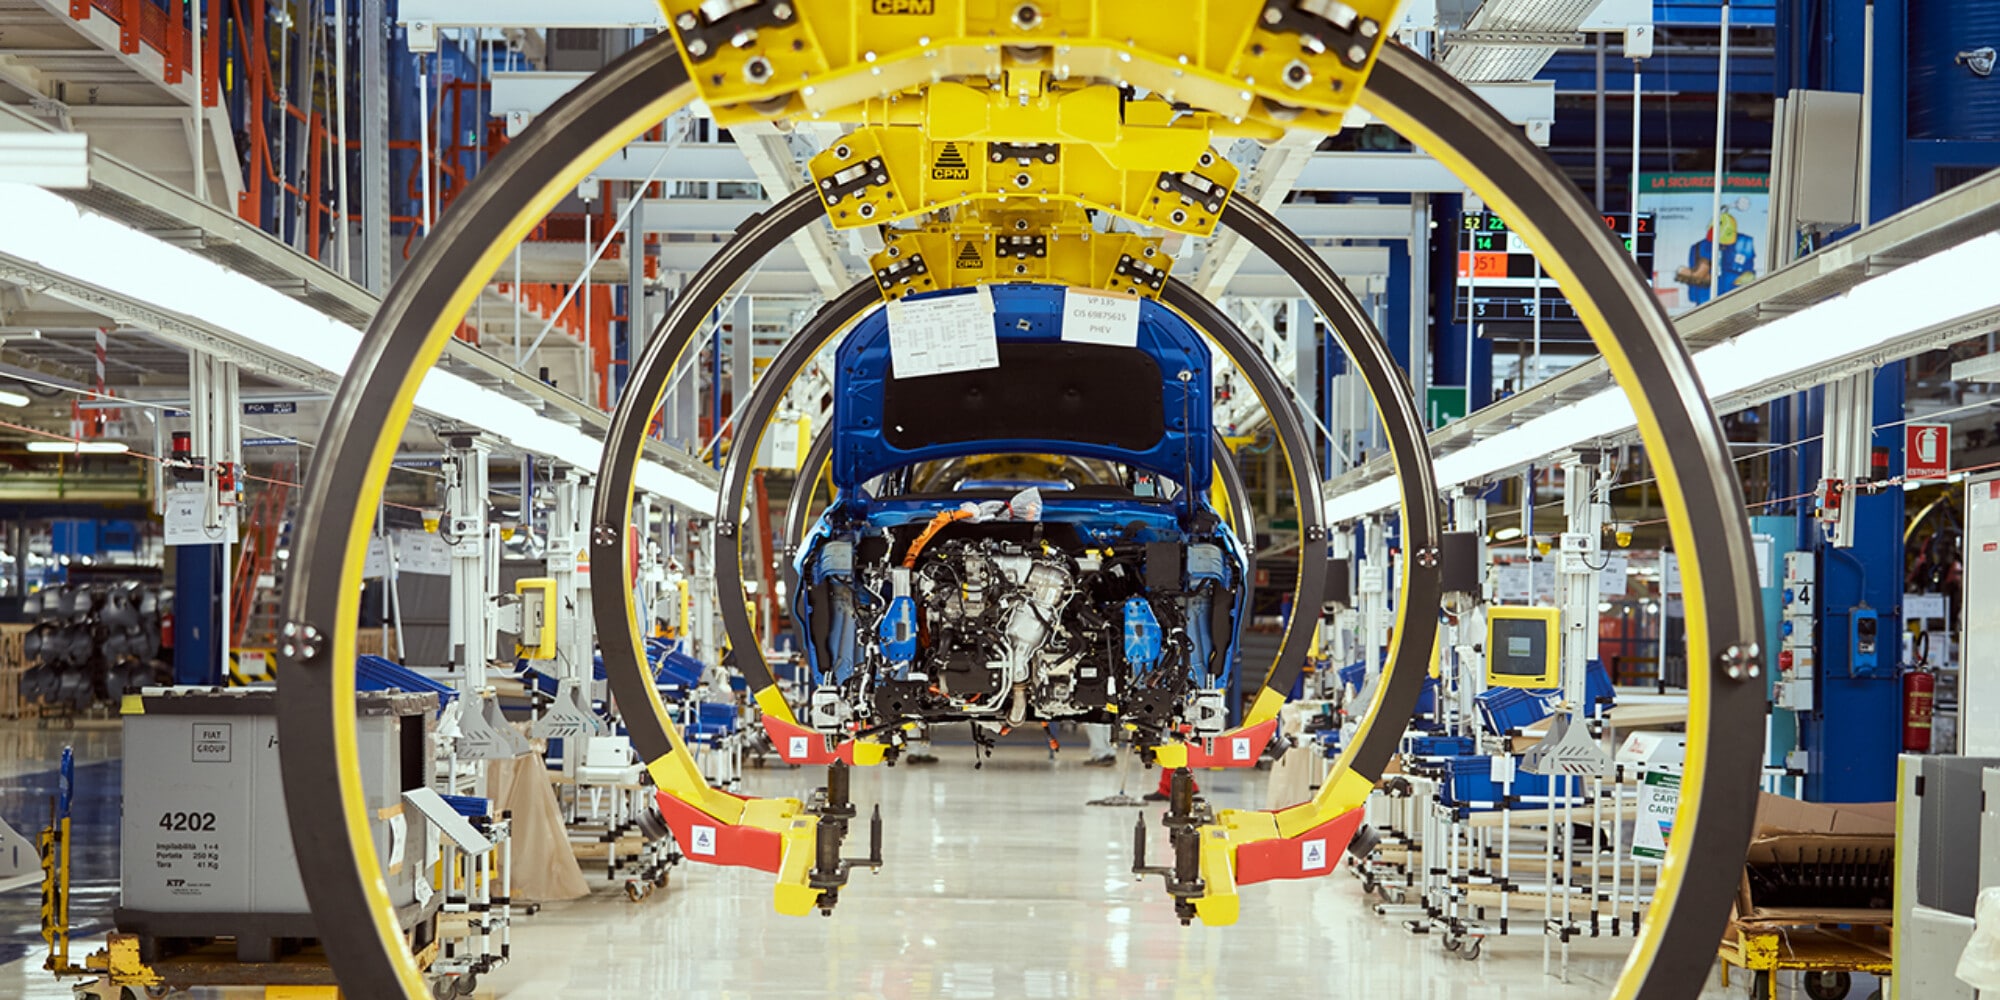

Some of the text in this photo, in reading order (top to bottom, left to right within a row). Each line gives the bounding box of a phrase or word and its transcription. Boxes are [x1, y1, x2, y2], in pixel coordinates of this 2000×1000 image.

[875, 0, 932, 14] CPM
[934, 169, 967, 179] CPM
[1652, 178, 1665, 188] LA
[1668, 176, 1724, 188] SICUREZZ
[1727, 176, 1763, 188] PRIMA
[1464, 216, 1481, 229] 52
[1488, 217, 1505, 230] 22
[1600, 215, 1616, 230] 0
[1477, 237, 1492, 250] 14
[1477, 304, 1486, 316] 3
[1089, 325, 1111, 334] PHEV
[1798, 585, 1811, 605] 4
[203, 731, 222, 739] FIAT
[268, 735, 279, 748] i-
[197, 744, 226, 753] GROUP
[1648, 803, 1675, 815] CART
[159, 812, 216, 831] 4202
[156, 851, 183, 859] Portata
[207, 852, 219, 861] Kg
[207, 861, 219, 870] Kg
